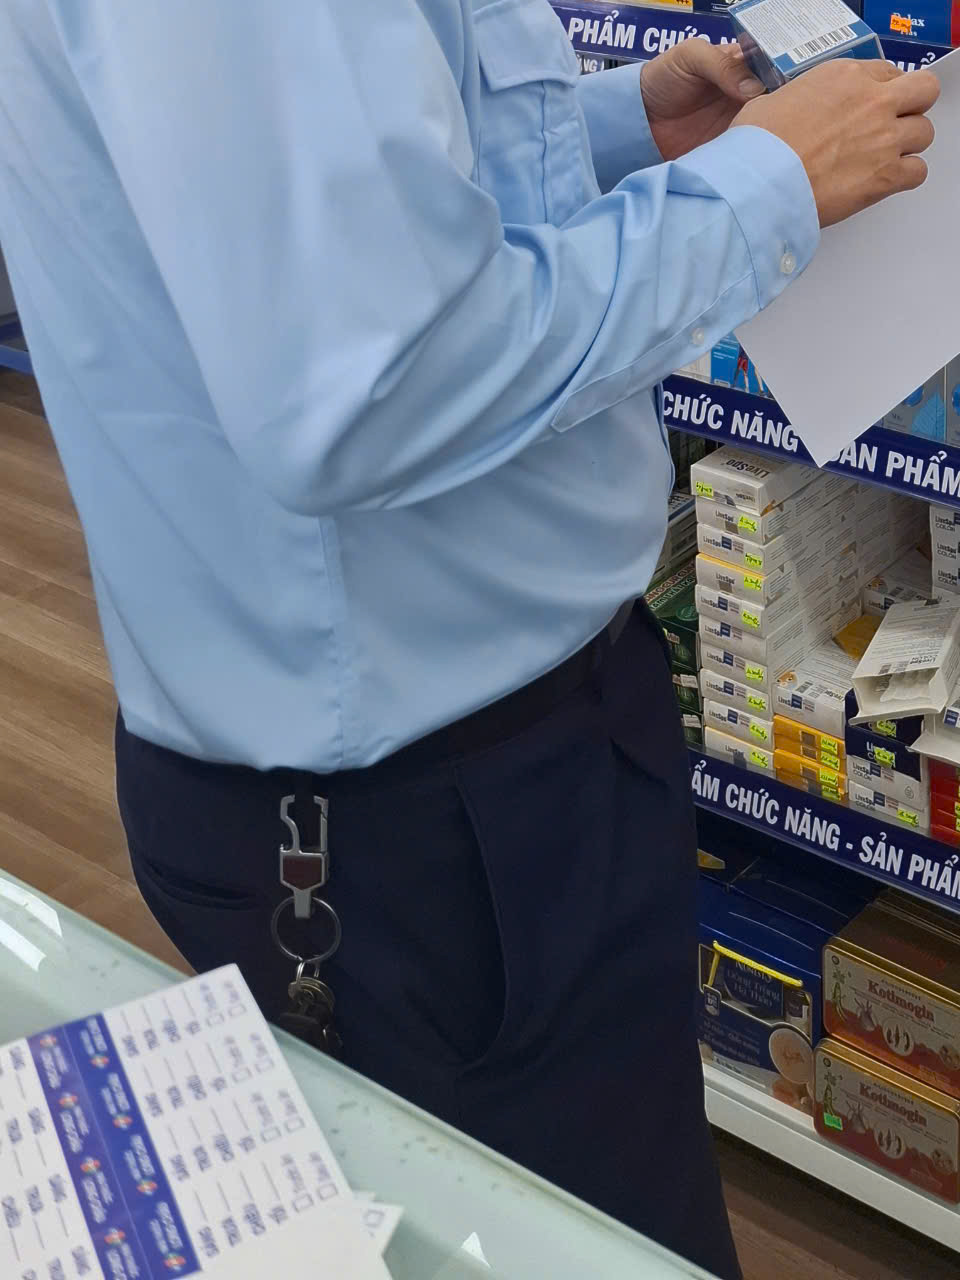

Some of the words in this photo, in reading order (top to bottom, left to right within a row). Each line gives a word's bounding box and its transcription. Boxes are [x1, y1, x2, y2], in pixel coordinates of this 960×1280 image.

[568, 10, 636, 50] PHẨM
[662, 390, 723, 427] CHỨC
[730, 408, 798, 452] NĂNG
[725, 782, 779, 825] CHỨC
[785, 805, 840, 850] NĂNG
[859, 832, 903, 875] SẢN
